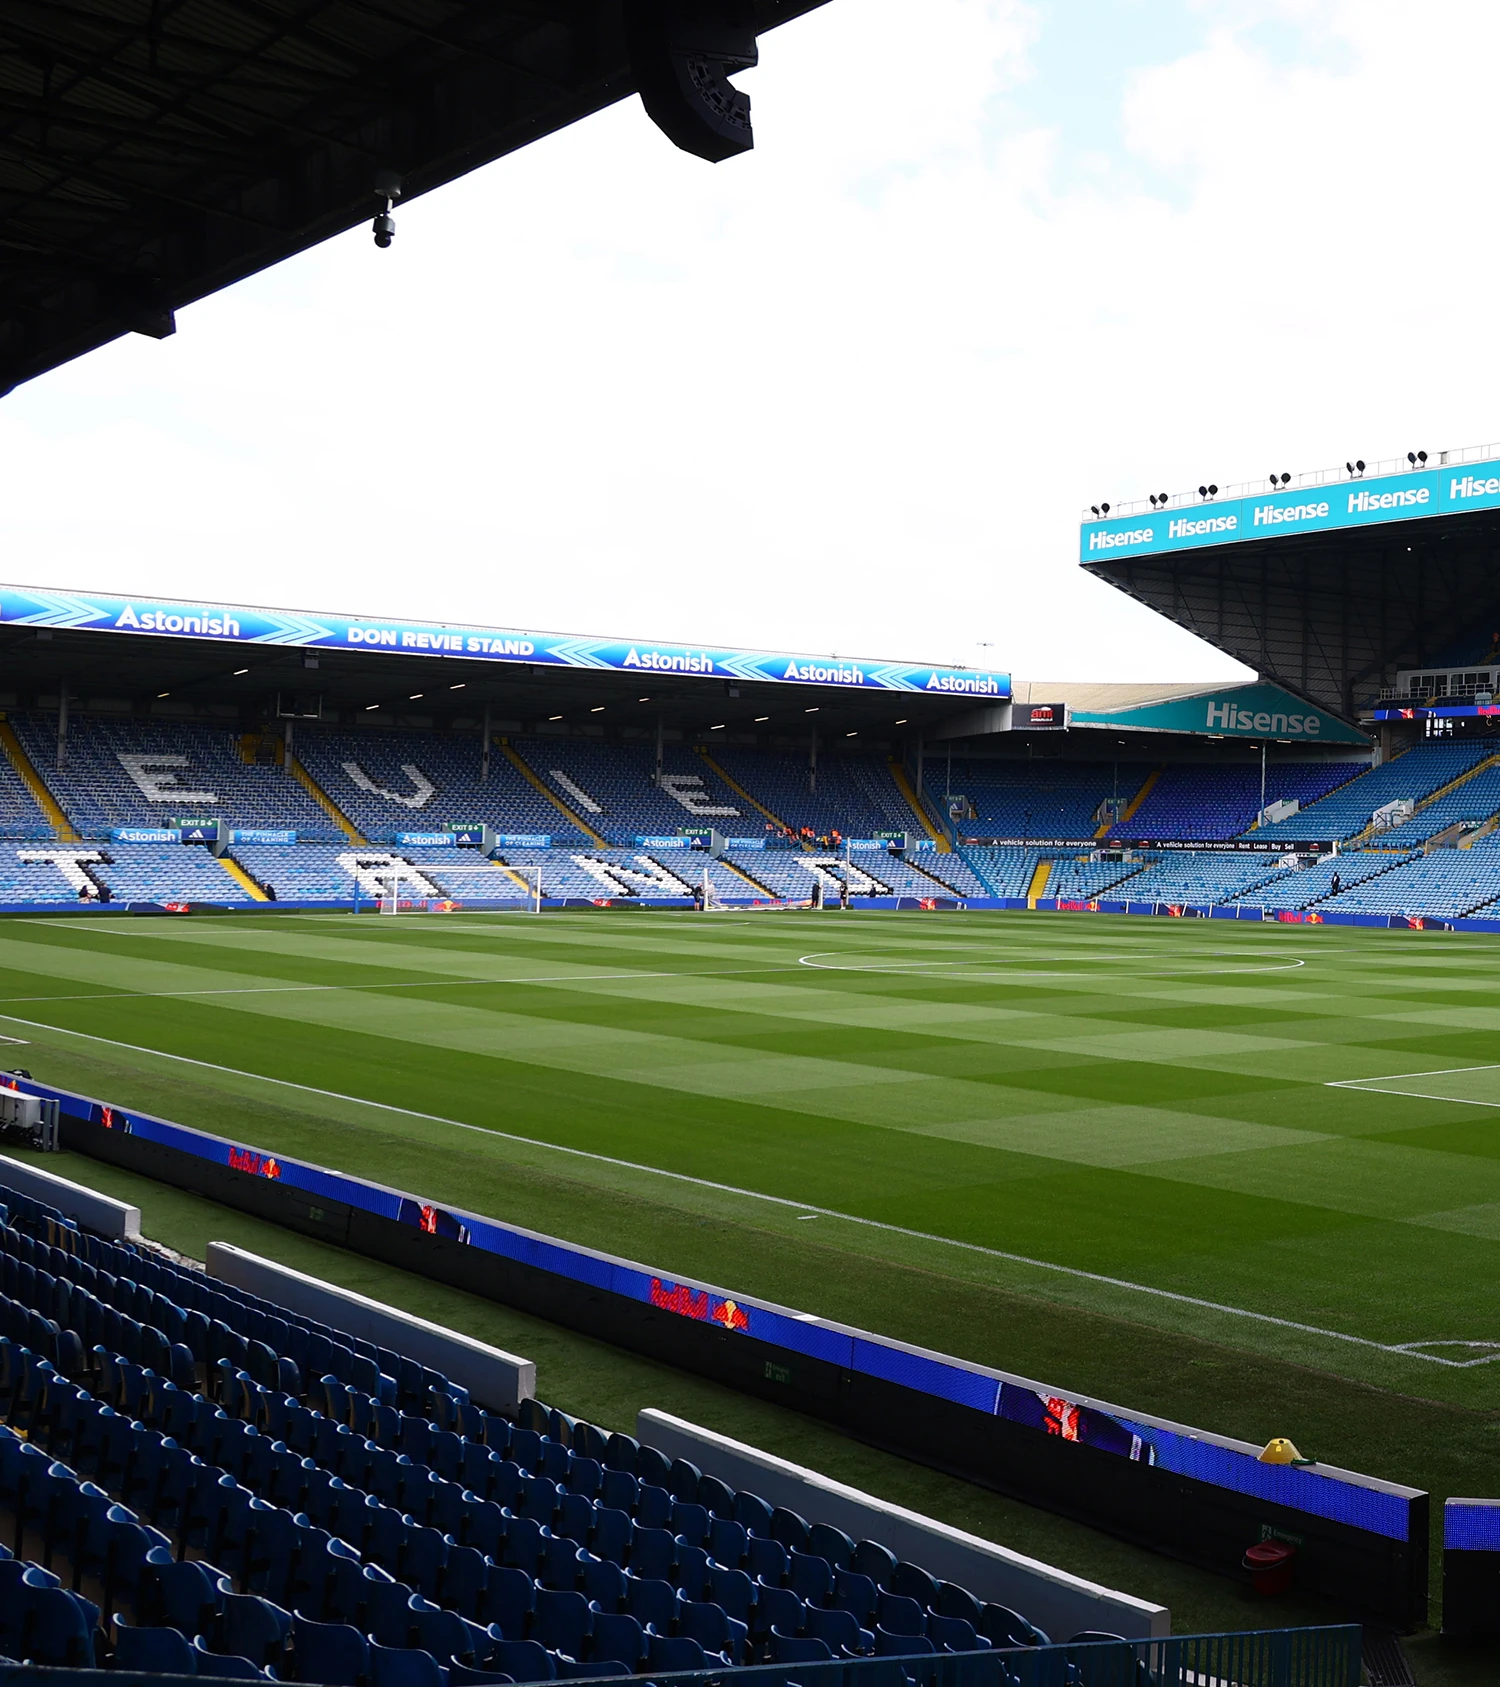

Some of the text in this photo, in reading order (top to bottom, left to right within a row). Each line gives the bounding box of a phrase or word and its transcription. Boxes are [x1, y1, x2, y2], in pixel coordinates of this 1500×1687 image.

[1347, 488, 1429, 513] Hisense
[1254, 502, 1329, 526] Hisense
[1168, 515, 1237, 538] Hisense
[1089, 528, 1153, 550] Hisense
[115, 604, 240, 636] Astonish
[347, 627, 534, 656] DON REVIE STAND
[622, 647, 713, 673] Astonish
[783, 659, 864, 684] Astonish
[926, 671, 998, 694] Astonish
[1206, 701, 1320, 734] Hisense
[118, 830, 176, 842] Astonish
[402, 834, 450, 845] Astonish
[643, 838, 684, 848] Astonish
[1271, 843, 1281, 851] Buy
[652, 1278, 709, 1320] Red Bull
